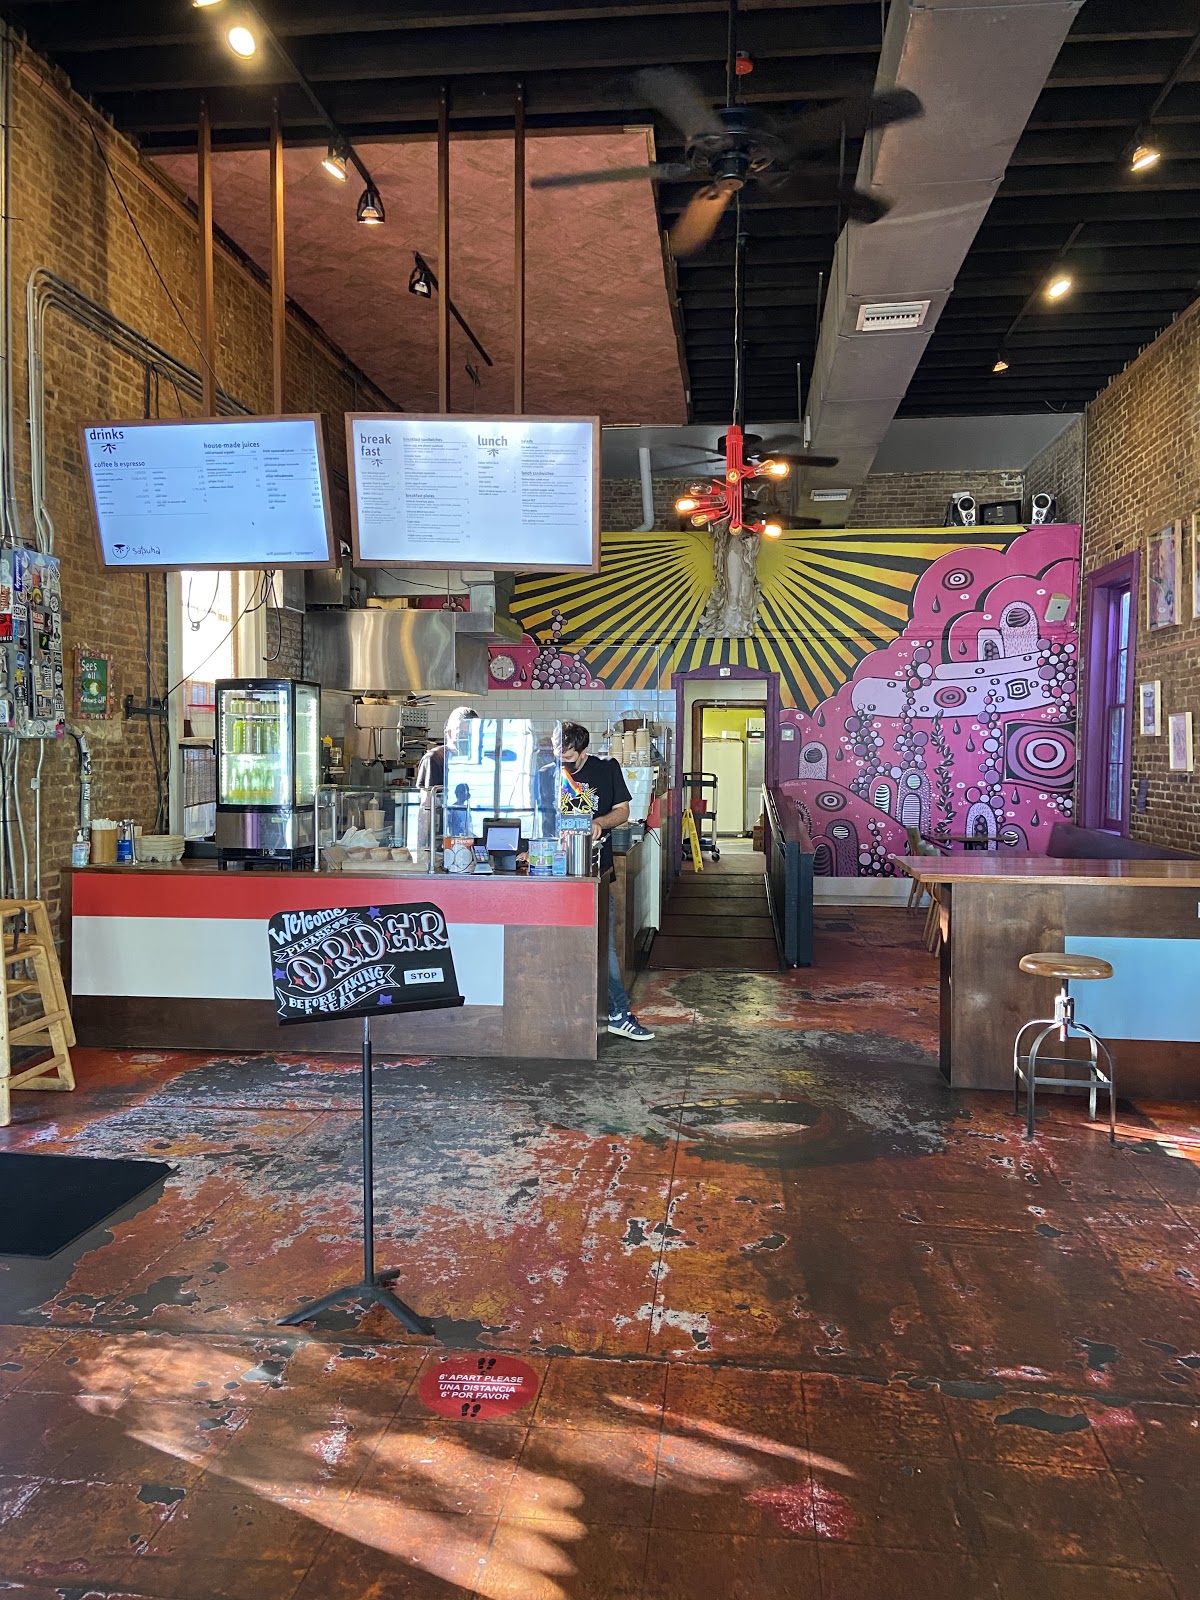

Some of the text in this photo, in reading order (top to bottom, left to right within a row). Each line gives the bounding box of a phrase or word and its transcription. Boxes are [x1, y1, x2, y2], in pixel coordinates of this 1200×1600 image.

[90, 428, 124, 440] drinks
[360, 433, 391, 444] break
[203, 441, 260, 450] house-made juices
[477, 435, 507, 446] lunch
[361, 445, 381, 457] fast
[81, 660, 97, 671] See's
[87, 672, 96, 680] all
[268, 907, 347, 946] Welcome
[286, 926, 333, 957] PLEASE
[286, 909, 449, 994] ORDER
[410, 971, 437, 980] STOP
[288, 966, 385, 1010] BEFORE TAKING
[319, 989, 357, 1012] SEAT
[449, 1374, 482, 1382] APART
[484, 1375, 523, 1383] PLEASE
[463, 1385, 516, 1393] DISTANCIA
